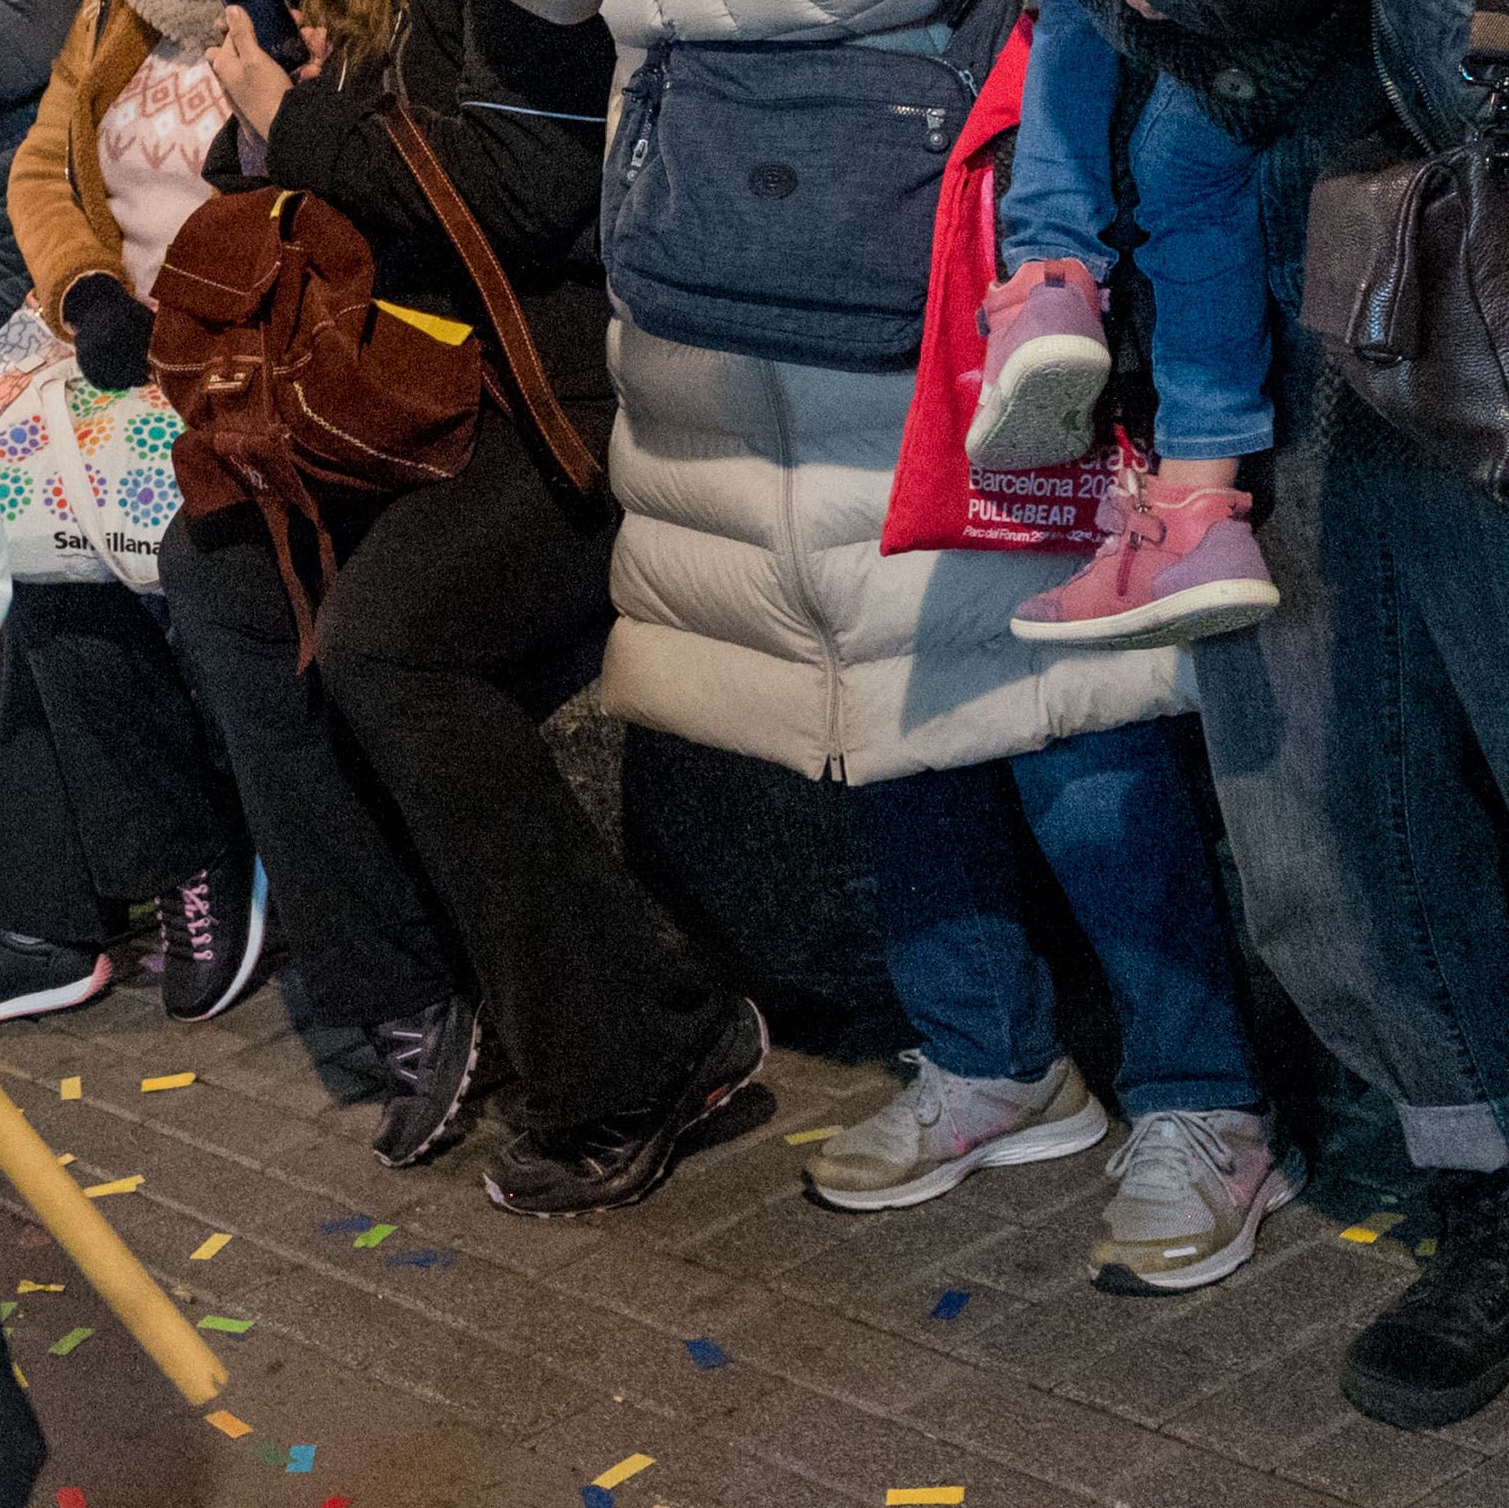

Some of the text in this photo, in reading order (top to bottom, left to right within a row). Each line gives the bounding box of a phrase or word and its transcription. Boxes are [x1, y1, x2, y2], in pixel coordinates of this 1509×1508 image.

[969, 466, 1074, 499] Barcelona
[967, 498, 1077, 526] PULL&BEAR
[53, 531, 162, 555] Sanillana
